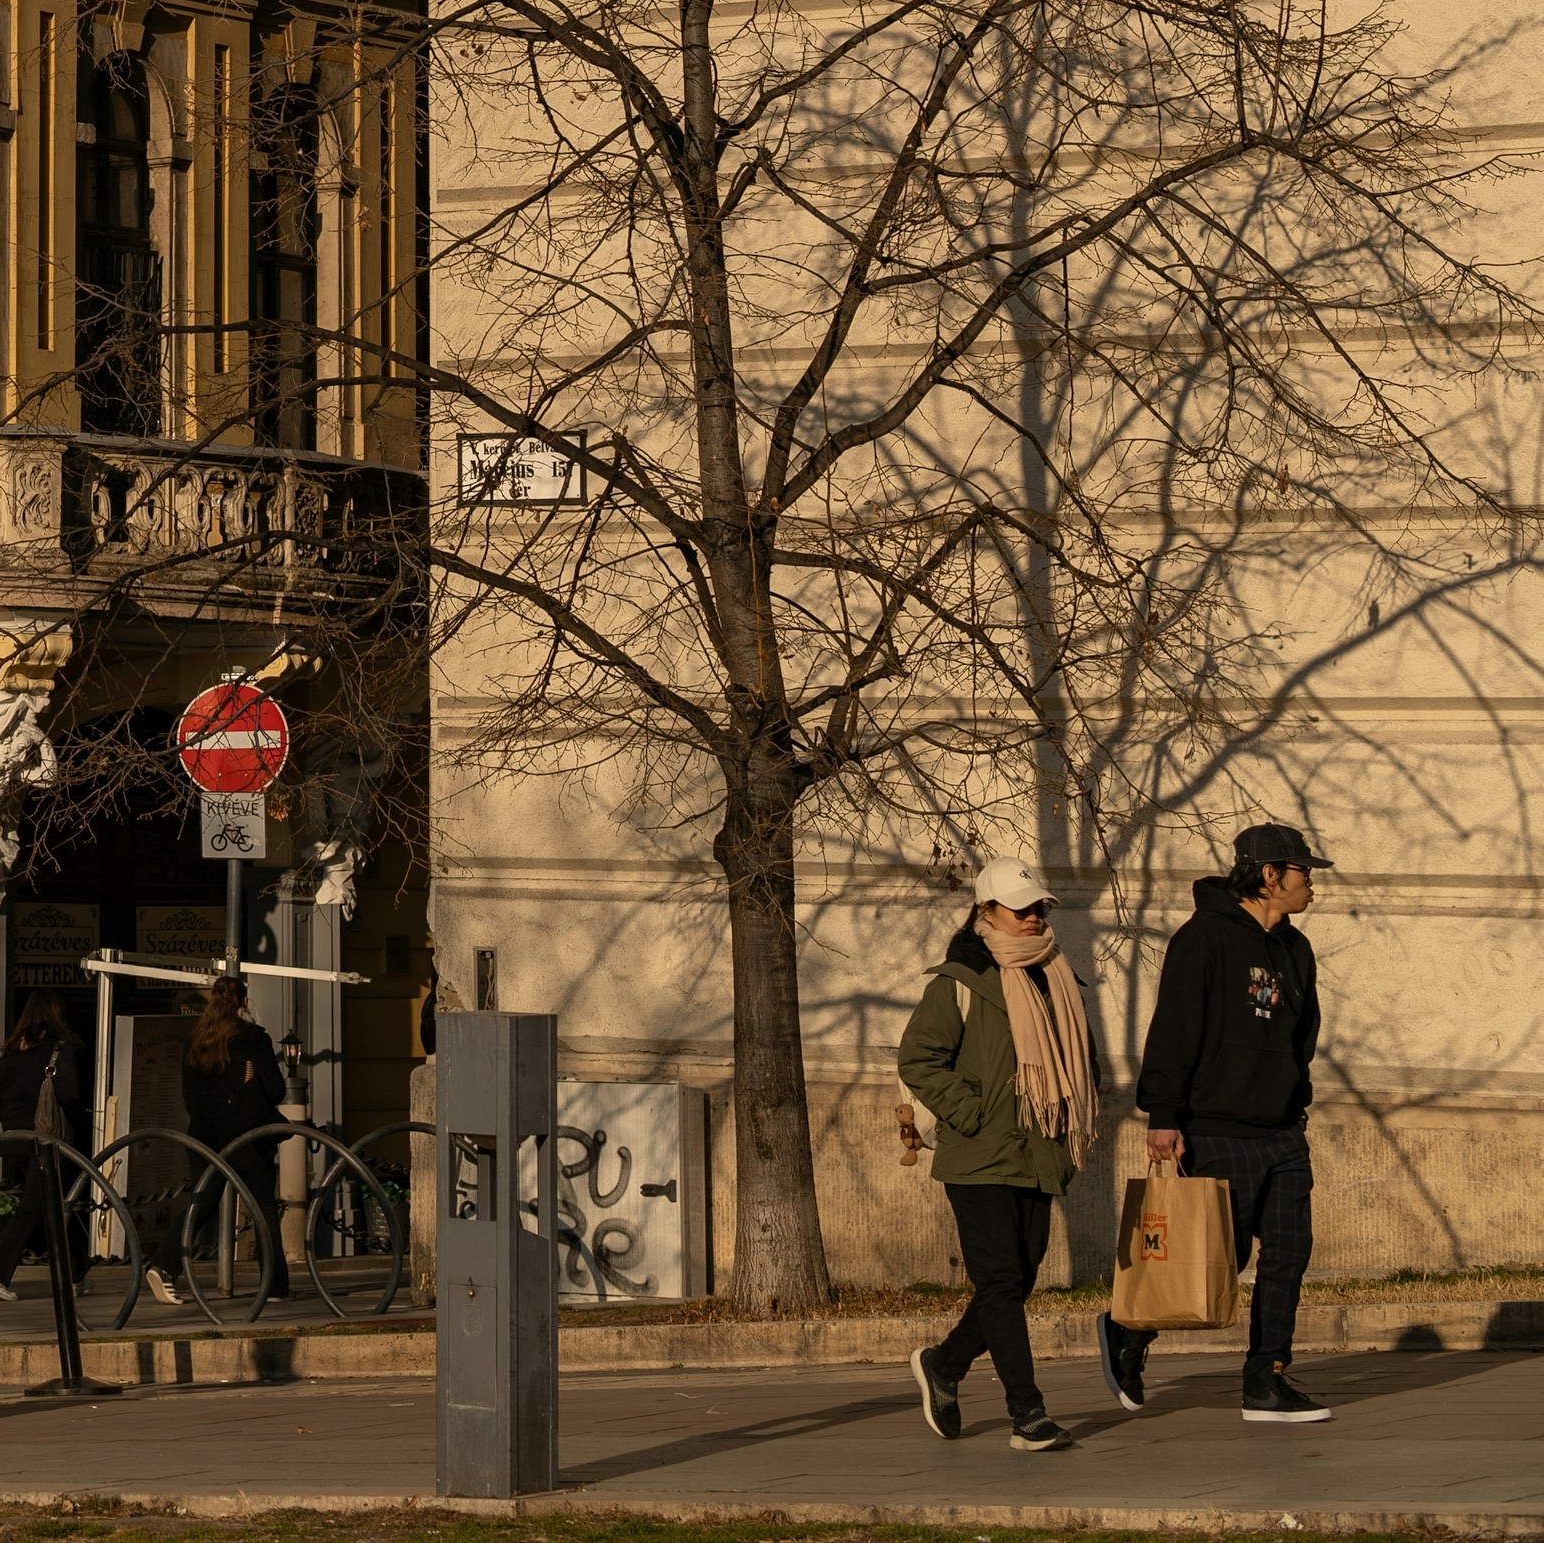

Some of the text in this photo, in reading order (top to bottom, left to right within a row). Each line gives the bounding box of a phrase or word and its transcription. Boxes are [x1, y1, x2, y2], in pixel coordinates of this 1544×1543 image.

[208, 799, 259, 816] KIVÉVE
[145, 931, 227, 955] Százéves
[1144, 1233, 1160, 1250] M
